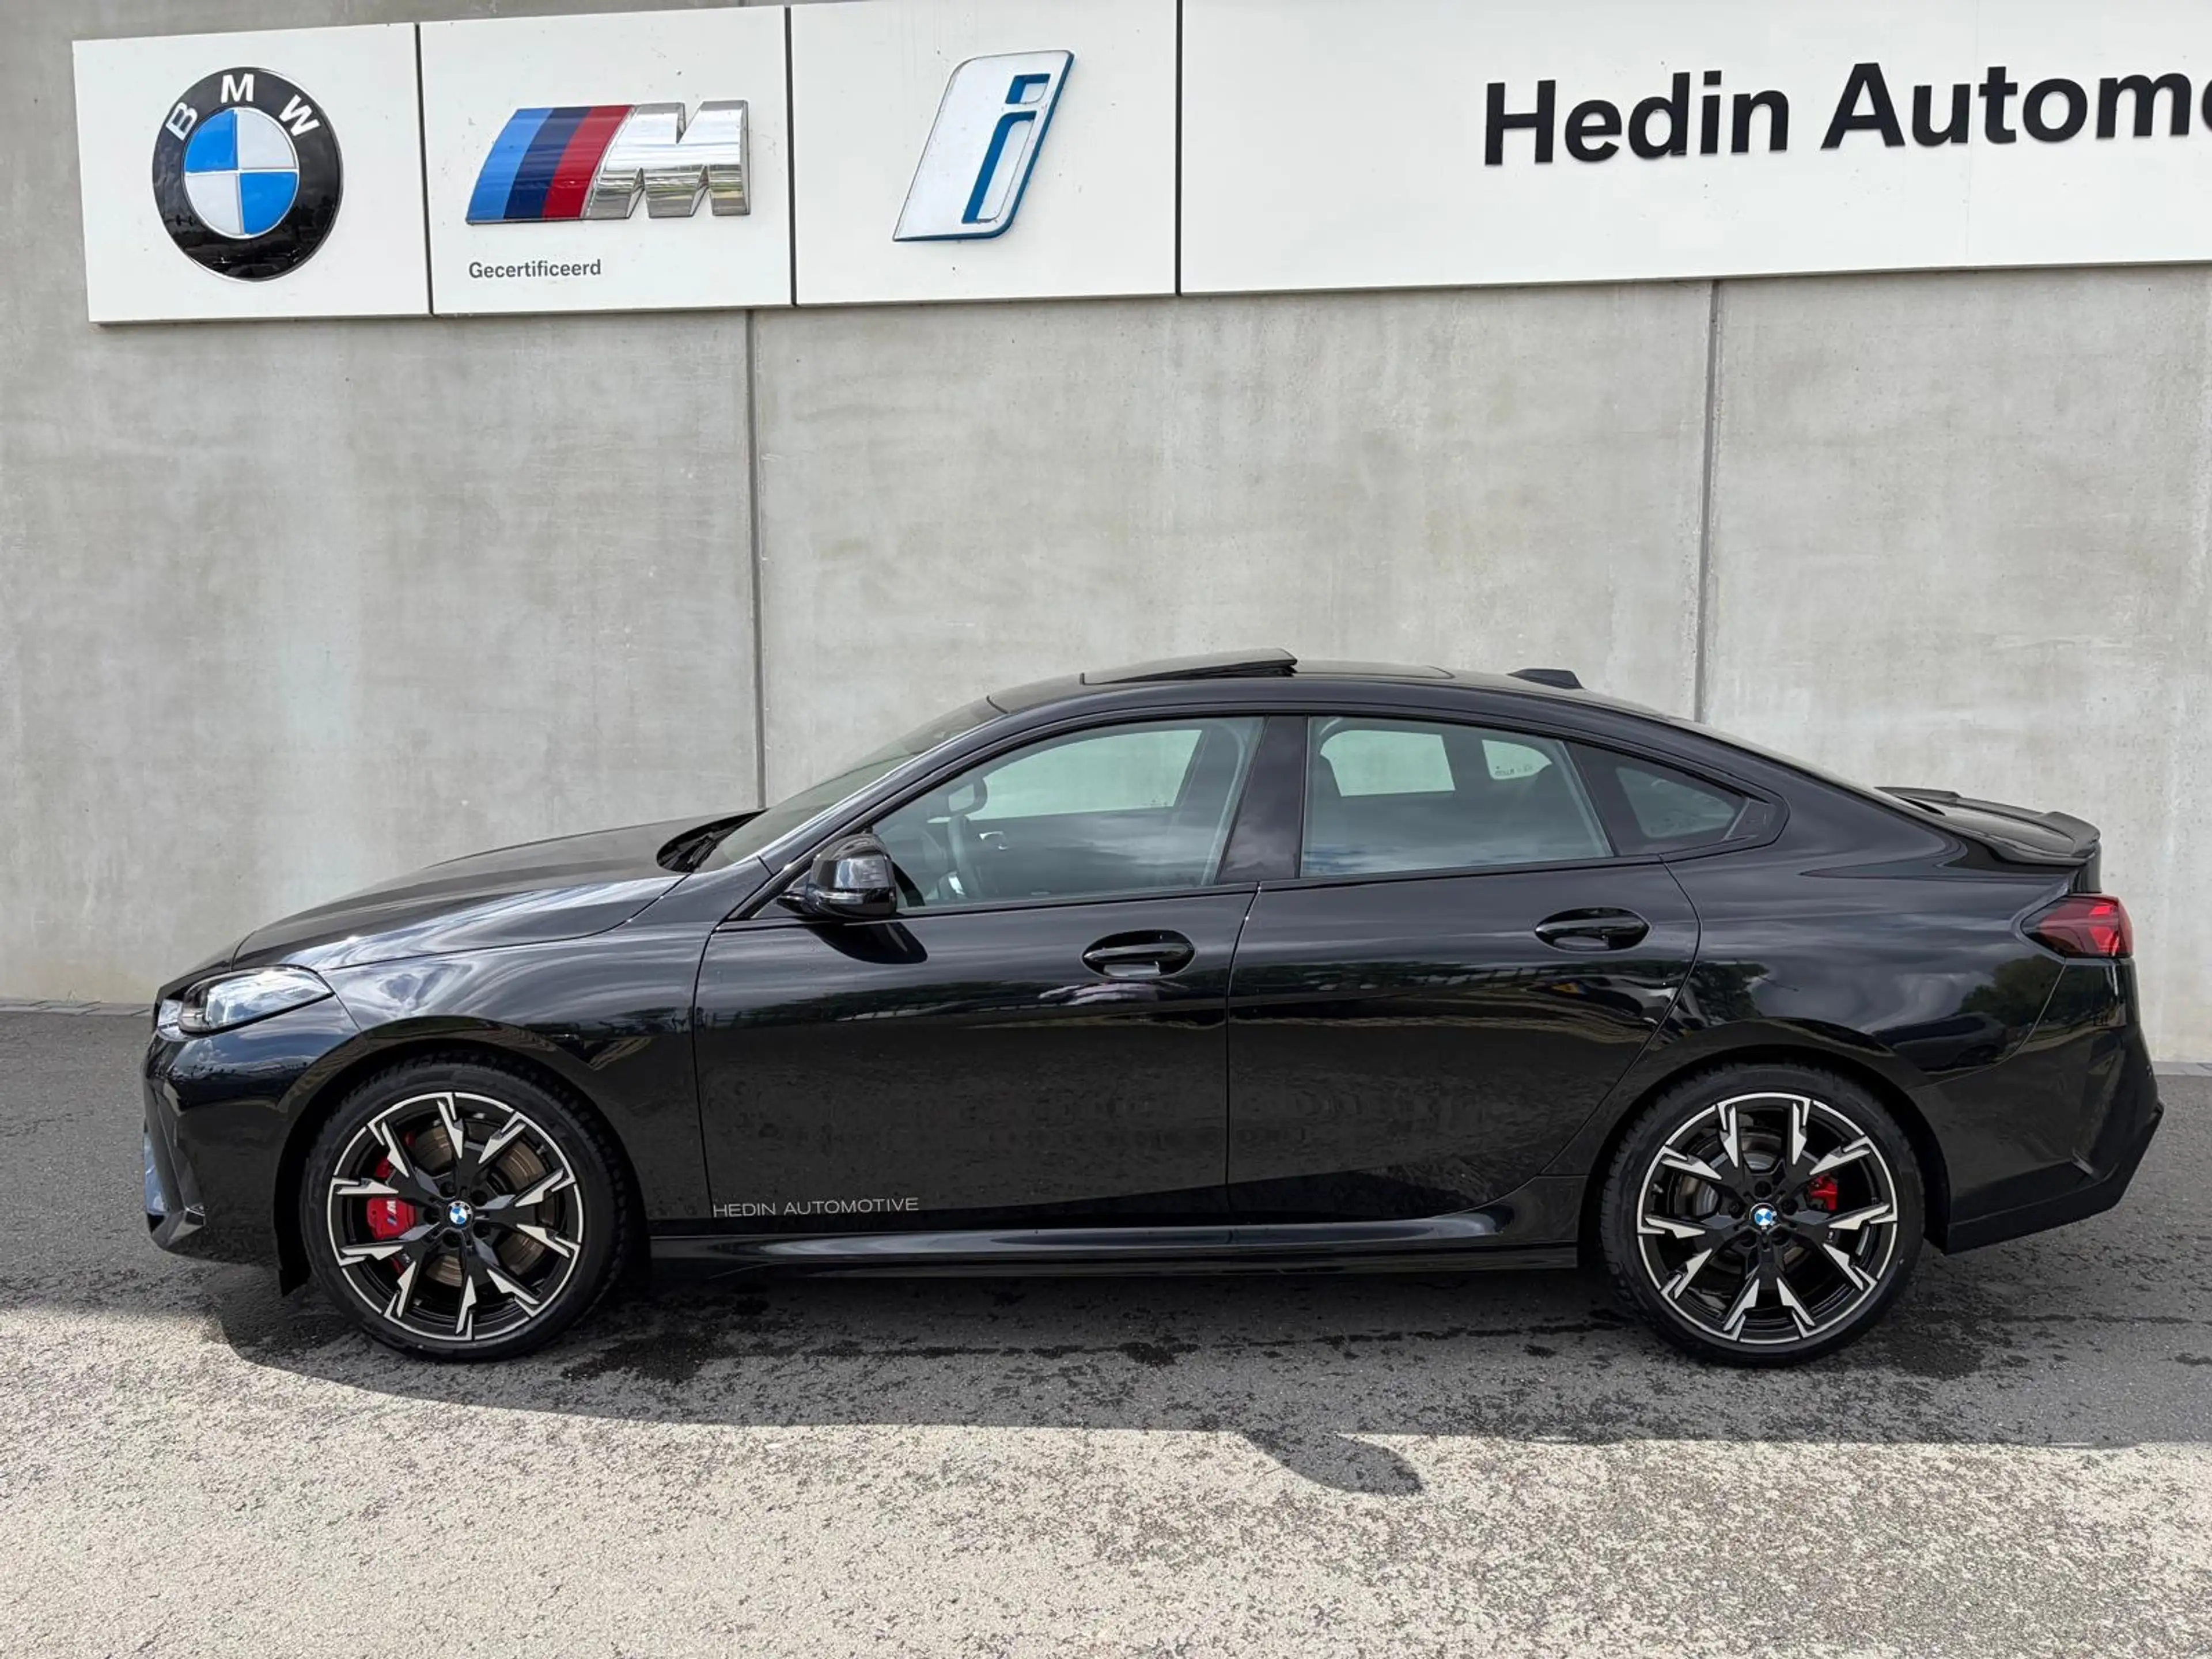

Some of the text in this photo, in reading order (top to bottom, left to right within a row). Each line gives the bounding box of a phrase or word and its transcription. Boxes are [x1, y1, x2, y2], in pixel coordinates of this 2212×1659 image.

[165, 73, 320, 141] BMW
[1485, 63, 2212, 165] Hedin Autom
[579, 100, 751, 219] M
[468, 259, 601, 279] Gecertificeerd
[713, 1197, 919, 1218] HEDIN AUTOMOTIVE
